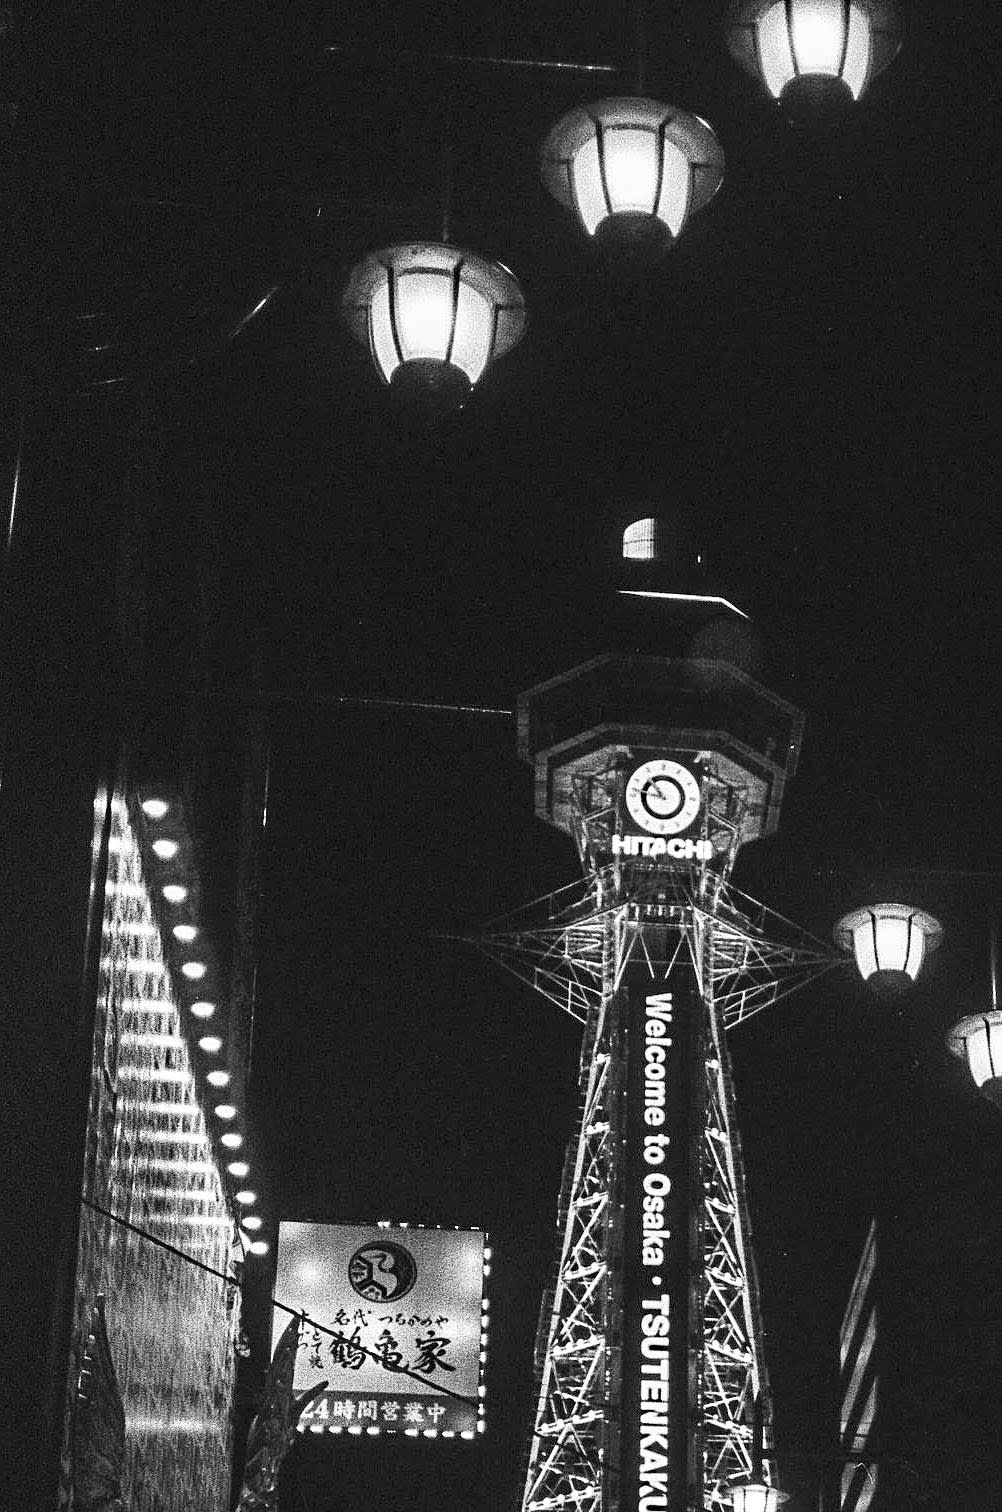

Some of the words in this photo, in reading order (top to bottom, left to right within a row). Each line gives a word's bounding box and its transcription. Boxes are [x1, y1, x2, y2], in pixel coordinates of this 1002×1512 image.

[611, 834, 714, 860] HITACHI
[643, 992, 673, 1127] Welcome
[643, 1134, 671, 1166] to
[642, 1172, 672, 1267] Osaka
[330, 1326, 456, 1374] 鶴亀家
[299, 1399, 448, 1424] 24時間営業中
